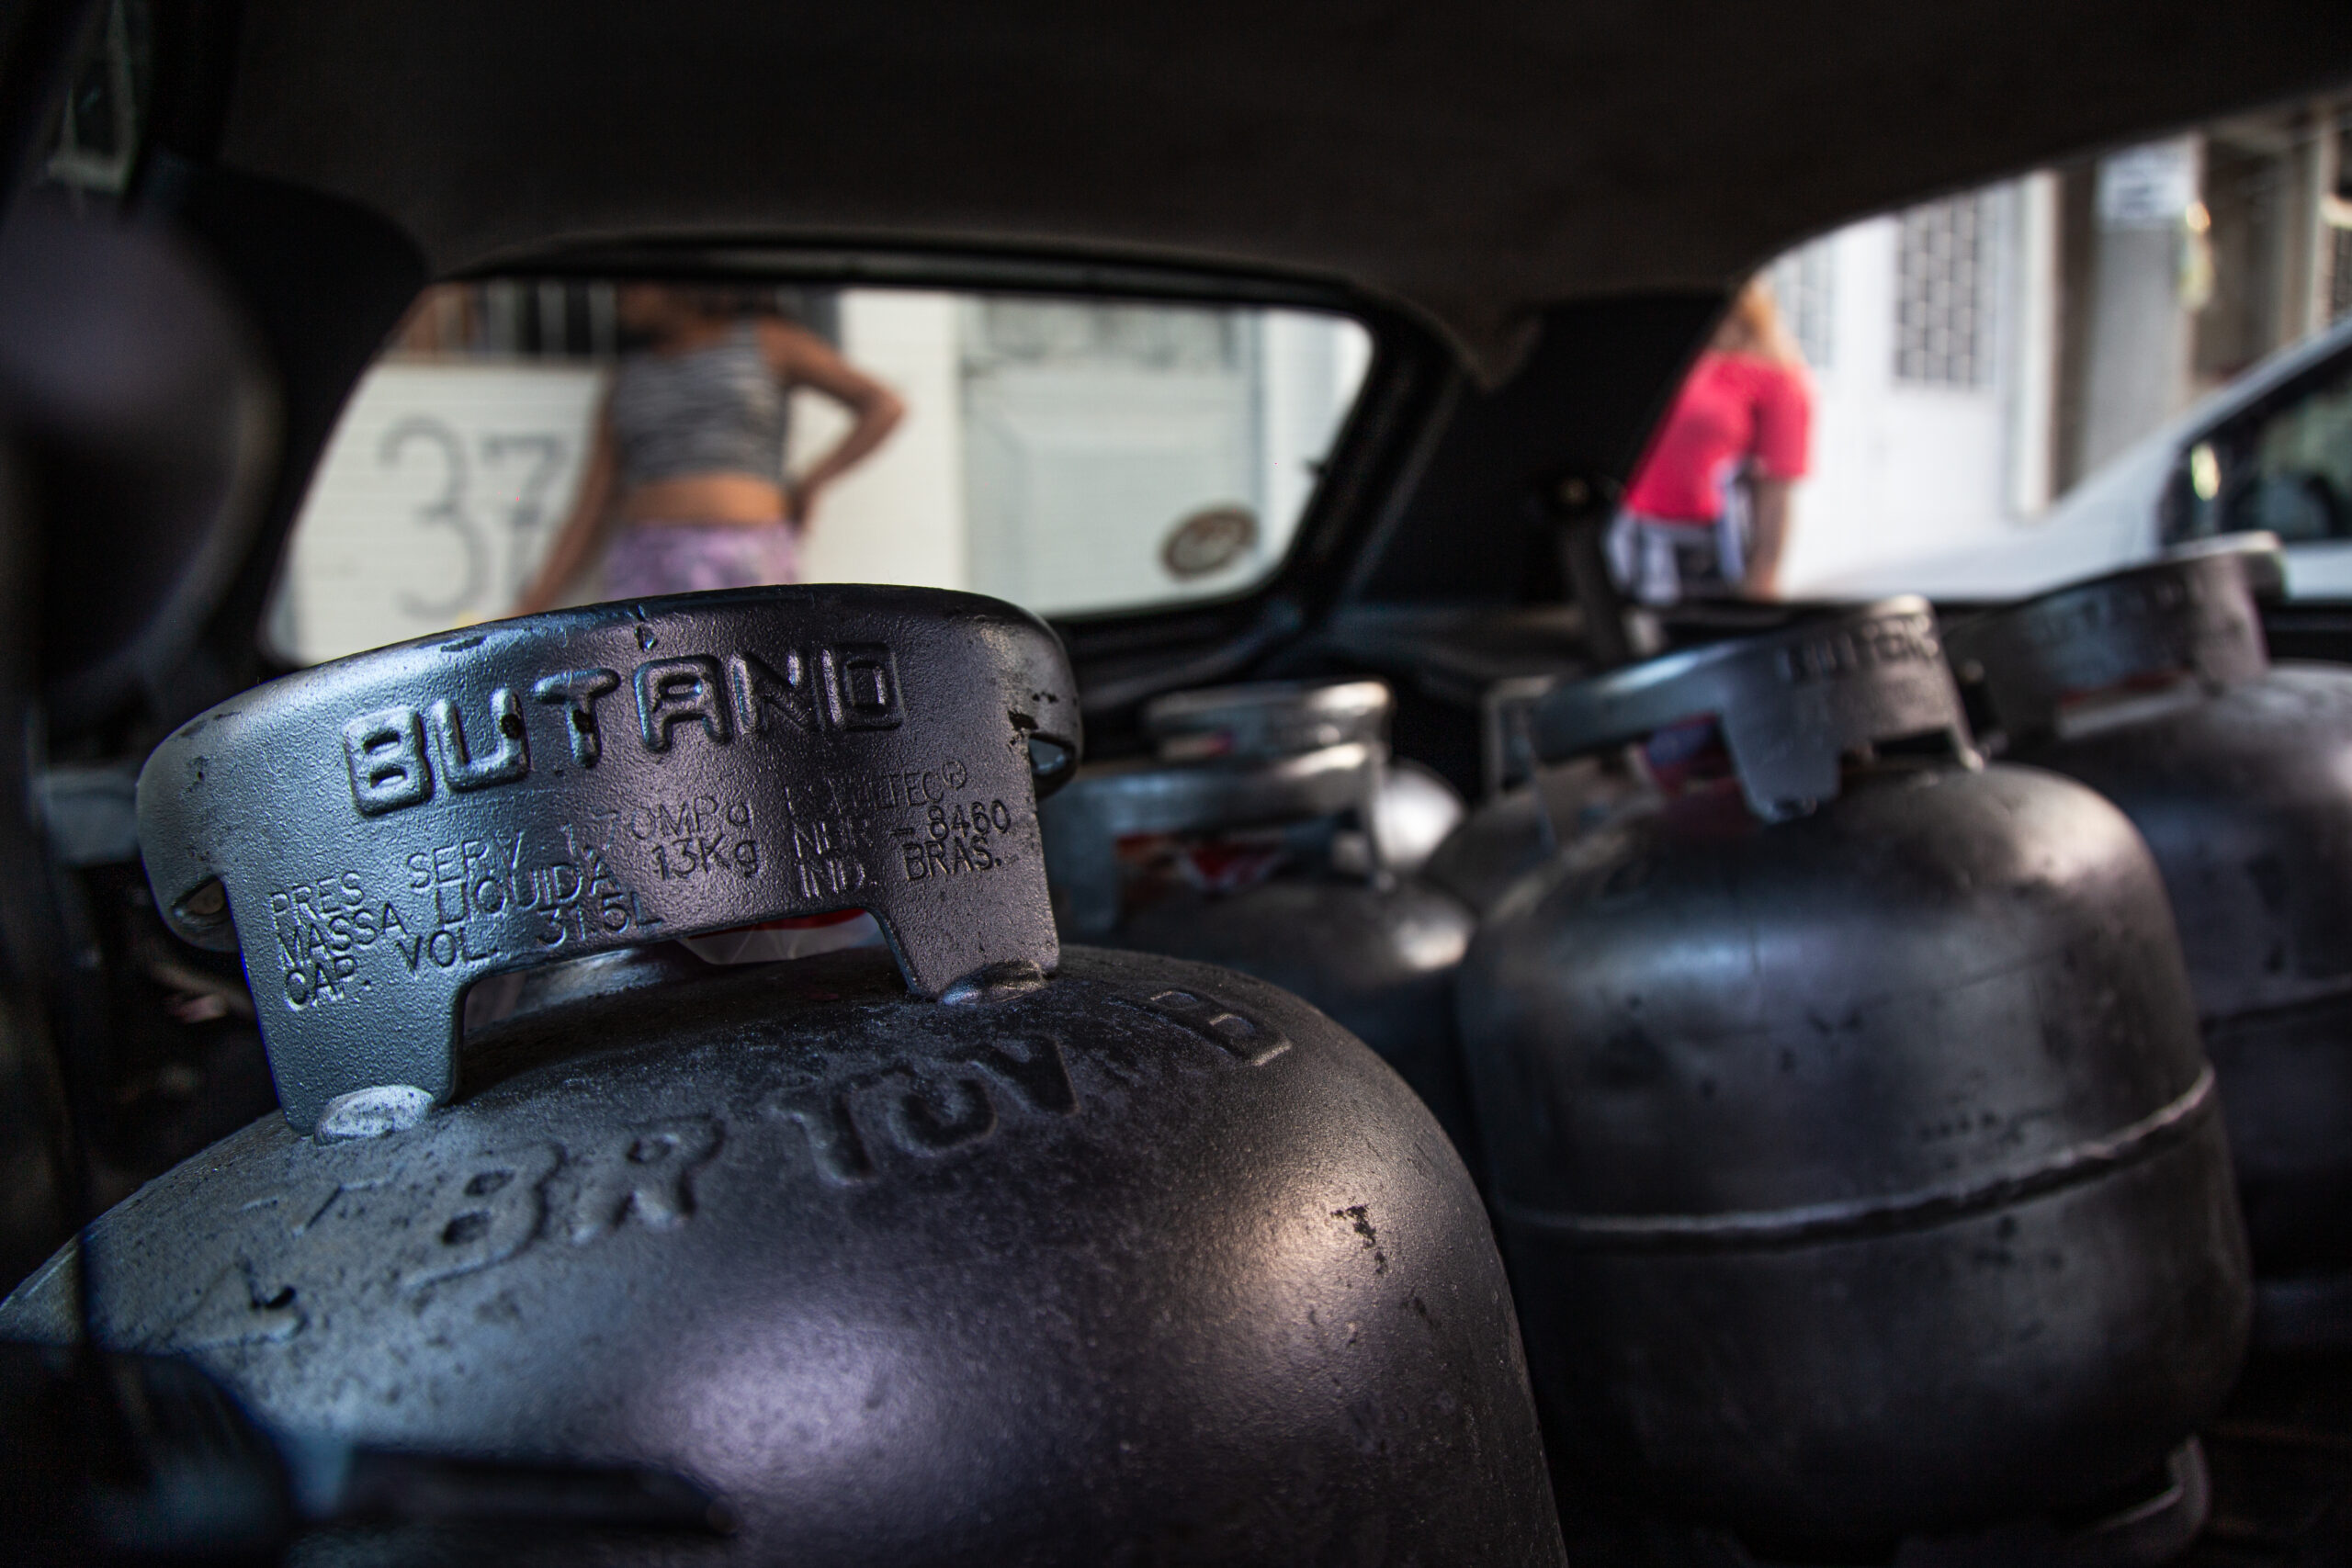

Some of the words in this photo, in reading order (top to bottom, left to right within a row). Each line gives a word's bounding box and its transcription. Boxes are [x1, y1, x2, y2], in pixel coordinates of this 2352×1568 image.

[343, 645, 908, 817] BUTANO
[927, 798, 1012, 841] 8460
[901, 835, 1003, 882] BRAS.
[270, 871, 366, 930] PRES
[277, 901, 410, 972] MASSA
[435, 855, 622, 931] LIQUIDA
[650, 833, 759, 883] 13Kg
